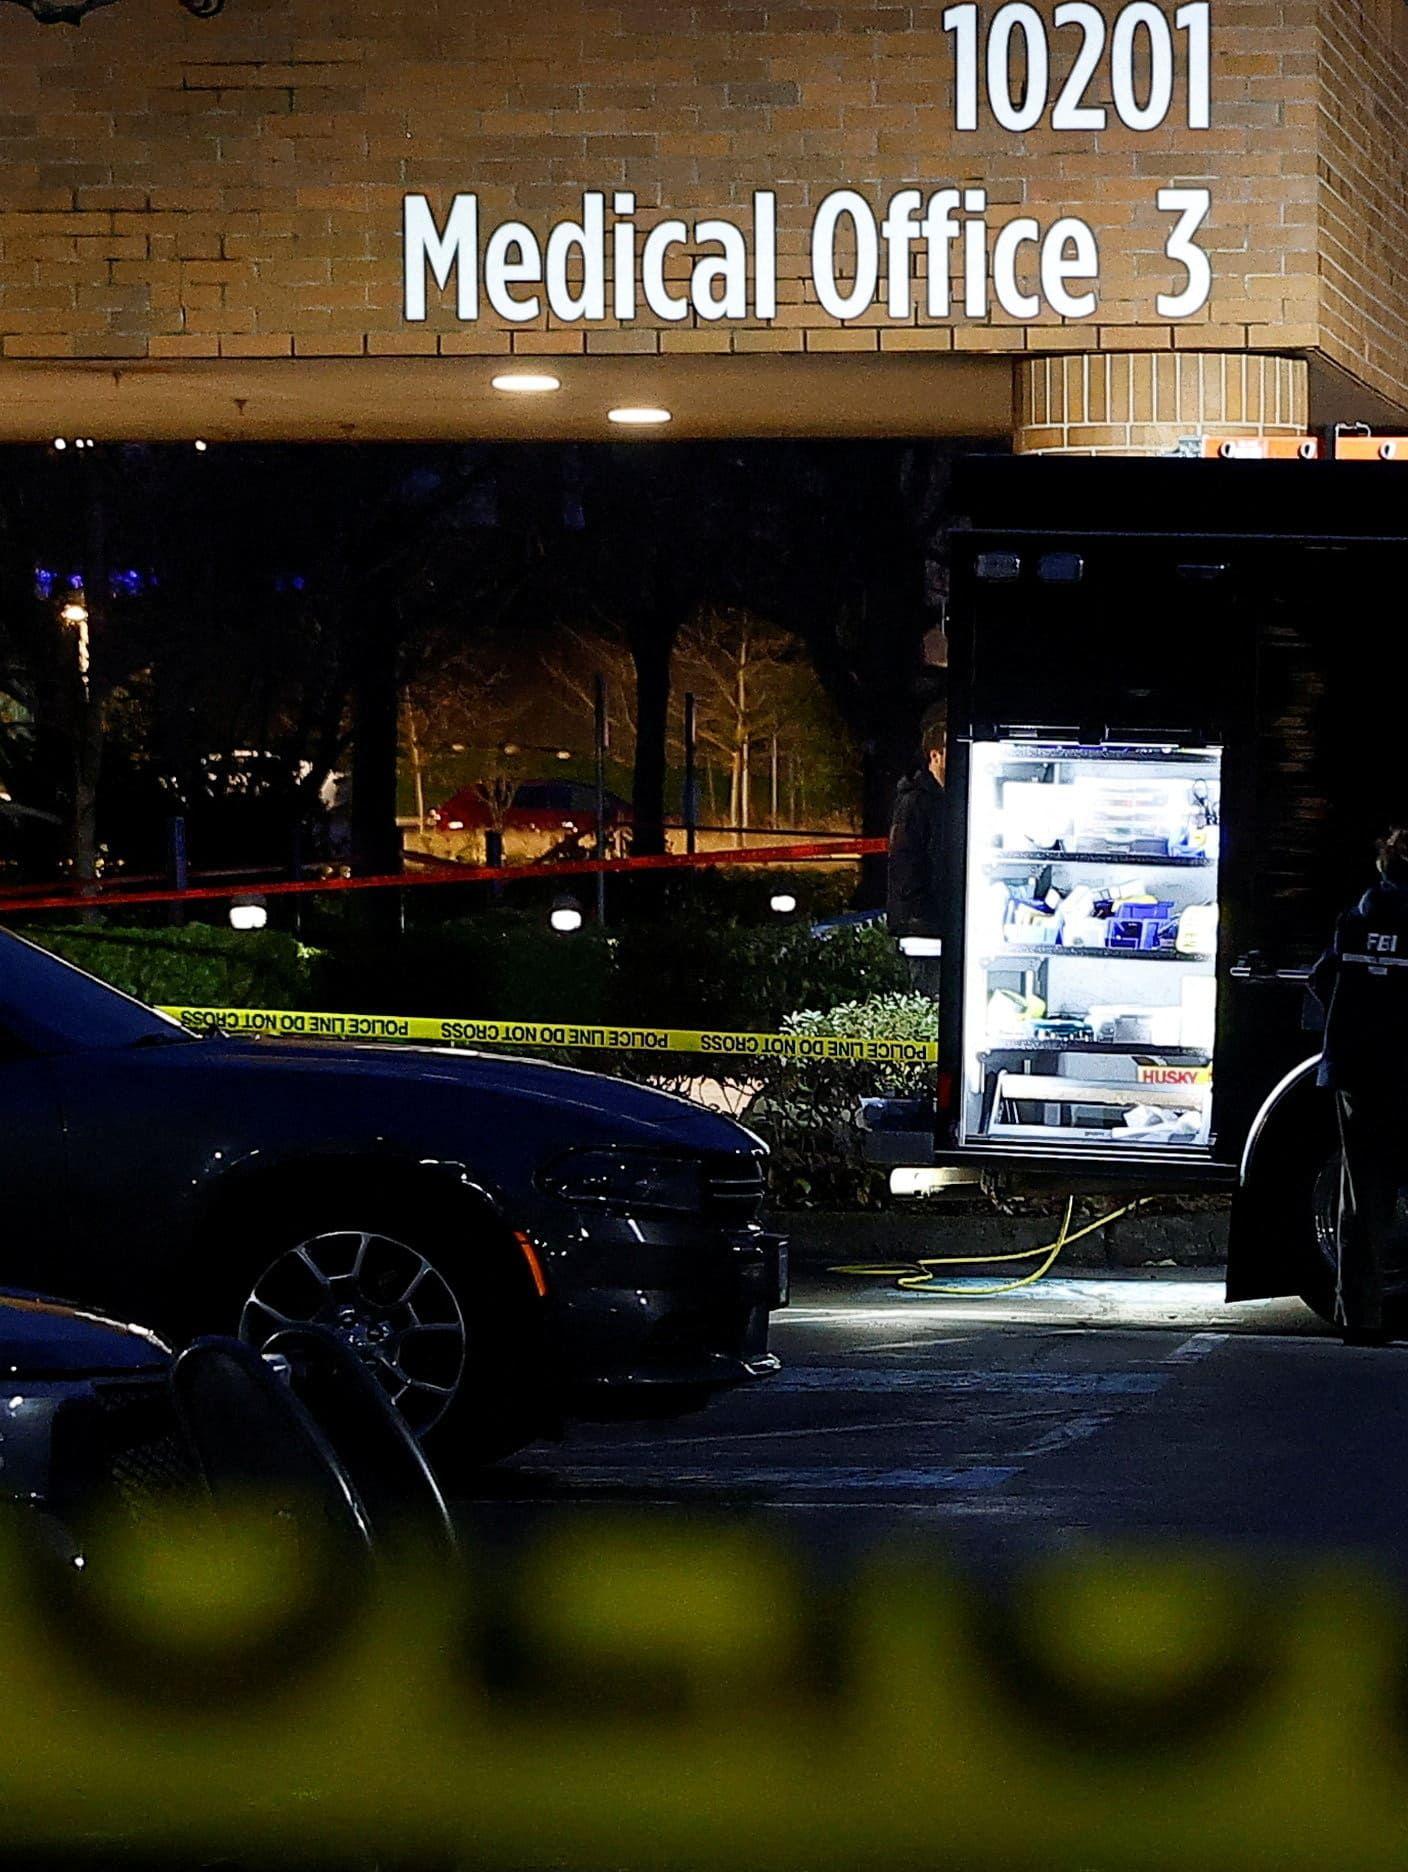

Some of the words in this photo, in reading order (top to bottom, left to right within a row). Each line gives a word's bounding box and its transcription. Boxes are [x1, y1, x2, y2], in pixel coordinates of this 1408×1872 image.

[944, 1, 1211, 132] 10201
[403, 190, 776, 322] Medical
[811, 188, 1100, 322] Office
[1156, 188, 1212, 319] 3
[1367, 932, 1398, 952] FBI
[181, 1011, 239, 1028] CROSS
[242, 1013, 277, 1029] NOT
[280, 1015, 305, 1030] DO
[309, 1016, 346, 1034] LINE
[350, 1018, 408, 1036] POLICE
[441, 1023, 499, 1040] CROSS
[502, 1025, 537, 1041] NOT
[540, 1027, 565, 1043] DO
[569, 1029, 605, 1046] LINE
[609, 1031, 669, 1048] POLICE
[701, 1035, 759, 1052] CROSS
[762, 1038, 796, 1054] NOT
[800, 1039, 824, 1056] DO
[828, 1040, 864, 1057] LINE
[867, 1043, 927, 1060] POLICE
[1143, 1069, 1199, 1084] HUSKY
